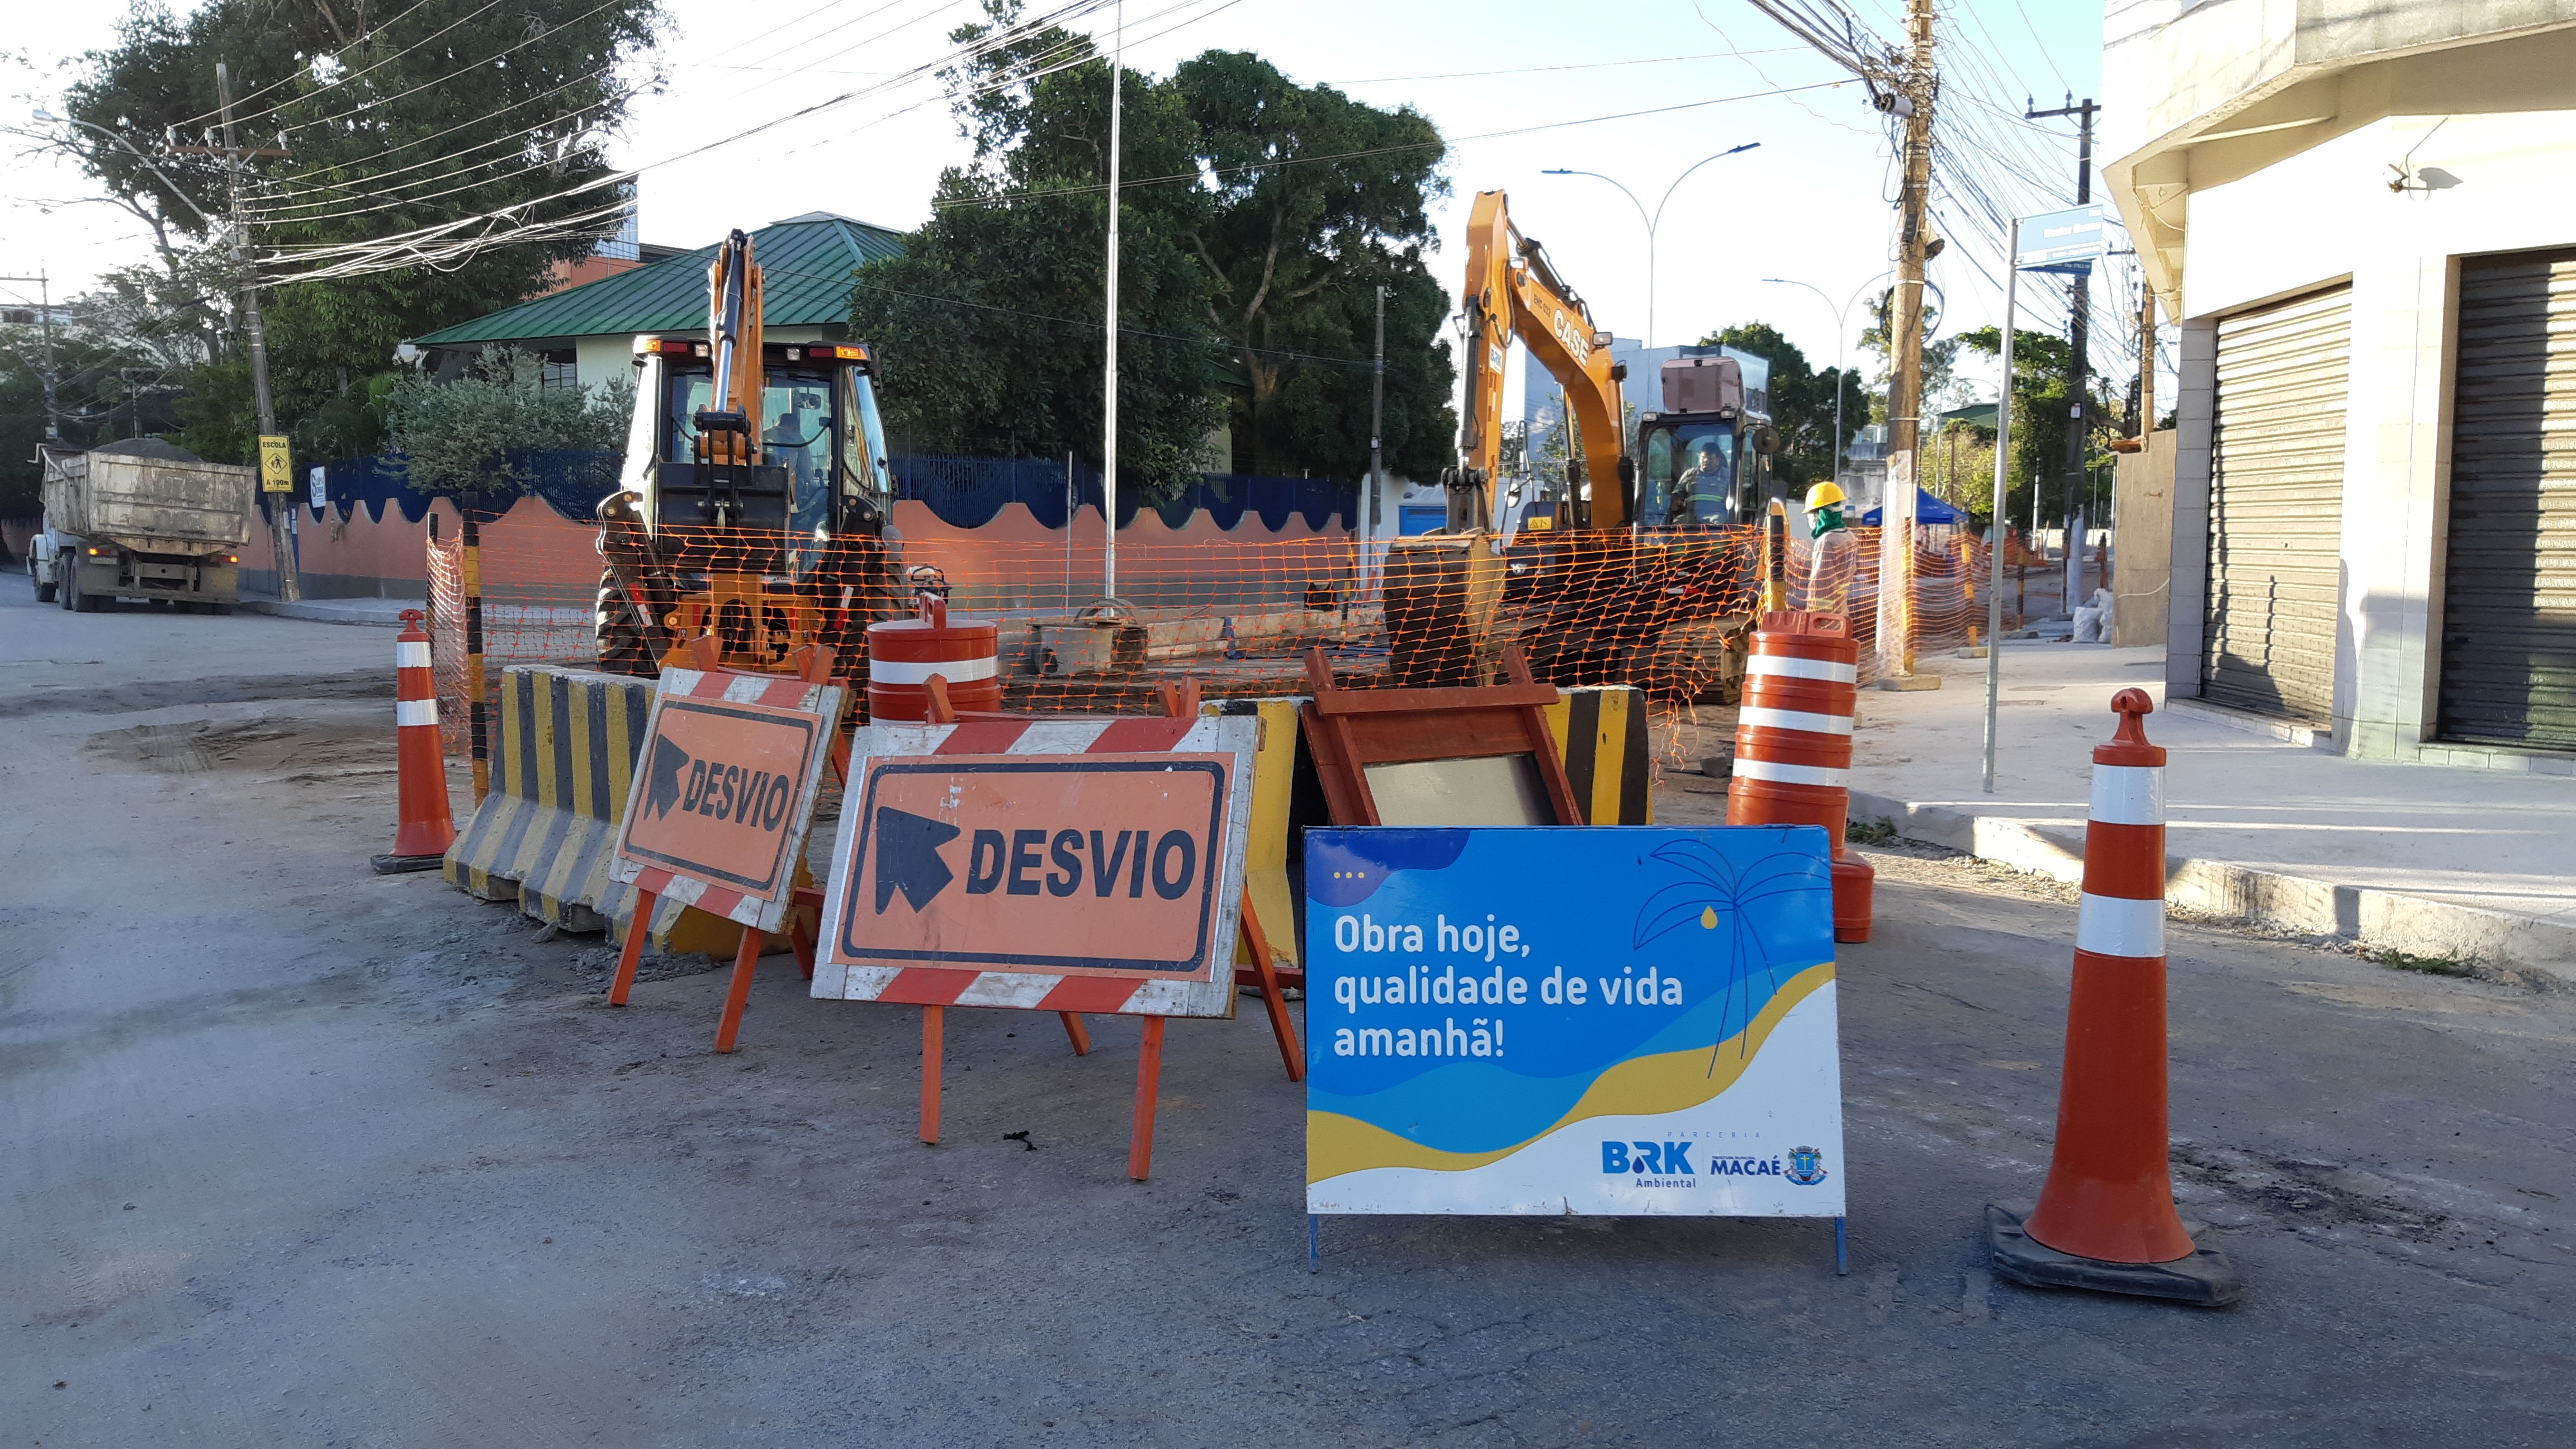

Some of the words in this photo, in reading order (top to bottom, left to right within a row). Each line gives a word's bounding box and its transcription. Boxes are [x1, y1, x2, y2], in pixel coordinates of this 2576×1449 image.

[1490, 348, 1502, 368] BRK
[1554, 308, 1589, 367] CASE
[681, 756, 789, 833] DESVIO
[965, 828, 1196, 900] DESVIO
[1334, 913, 1423, 953] Obra
[1437, 913, 1530, 962] hoje,
[1334, 965, 1528, 1014] qualidade
[1541, 965, 1588, 1005] de
[1599, 965, 1683, 1006] vida
[1334, 1017, 1504, 1057] amanhã!
[1602, 1141, 1696, 1175] BRK
[1710, 1155, 1781, 1176] MACAÉ
[1635, 1178, 1697, 1188] Ambiental
